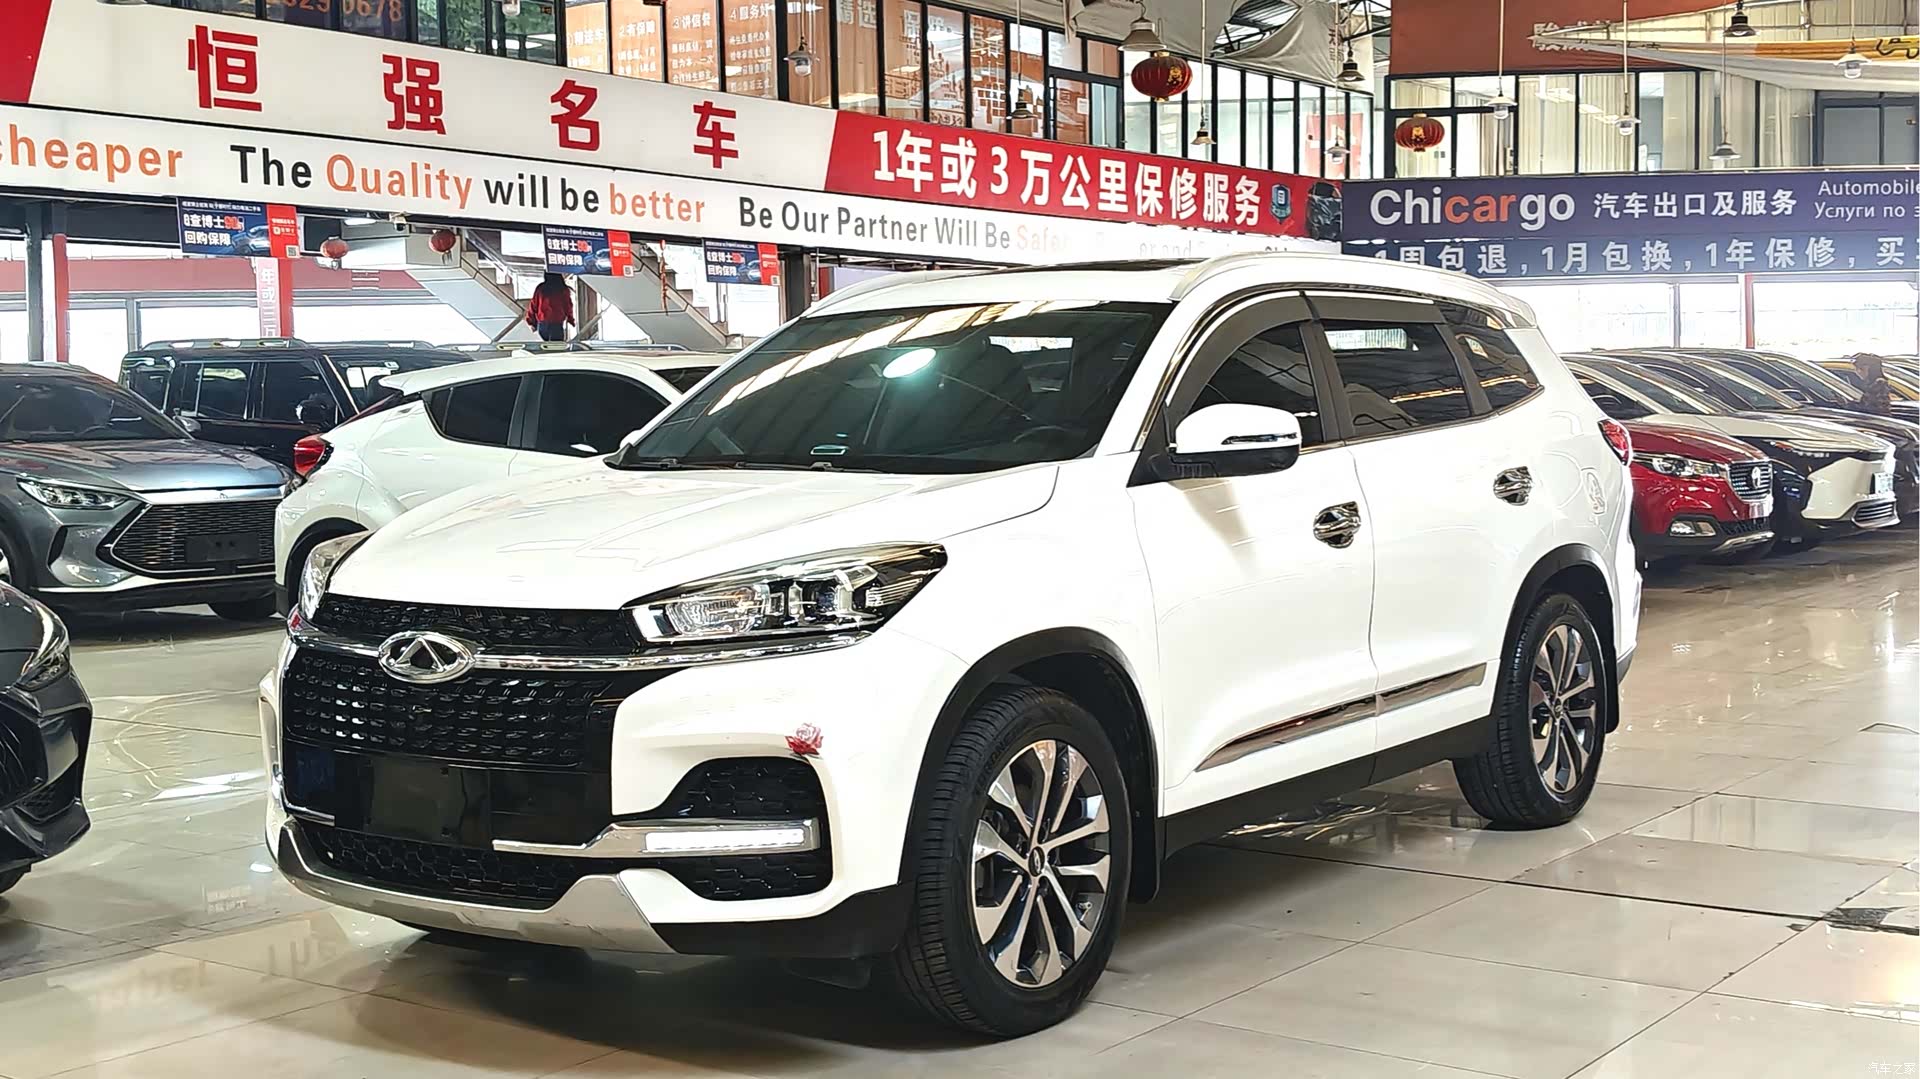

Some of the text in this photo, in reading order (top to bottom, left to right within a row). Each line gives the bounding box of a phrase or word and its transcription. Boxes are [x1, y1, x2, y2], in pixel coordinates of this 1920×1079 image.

[0, 124, 183, 183] heaper
[230, 145, 312, 188] The
[326, 153, 473, 209] Quality
[484, 173, 549, 209] will
[561, 178, 600, 213] be
[610, 184, 705, 223] better
[740, 197, 773, 228] Be
[781, 201, 830, 234] Our
[837, 207, 928, 243] Partner
[935, 215, 977, 247] Will
[985, 221, 1010, 249] Be
[872, 129, 1261, 227] 1年或3万公里保修服务
[1370, 186, 1576, 231] Chicargo
[1593, 189, 1797, 219] 汽车出口及服务
[1814, 202, 1876, 221] Услуги
[1883, 206, 1906, 218] по
